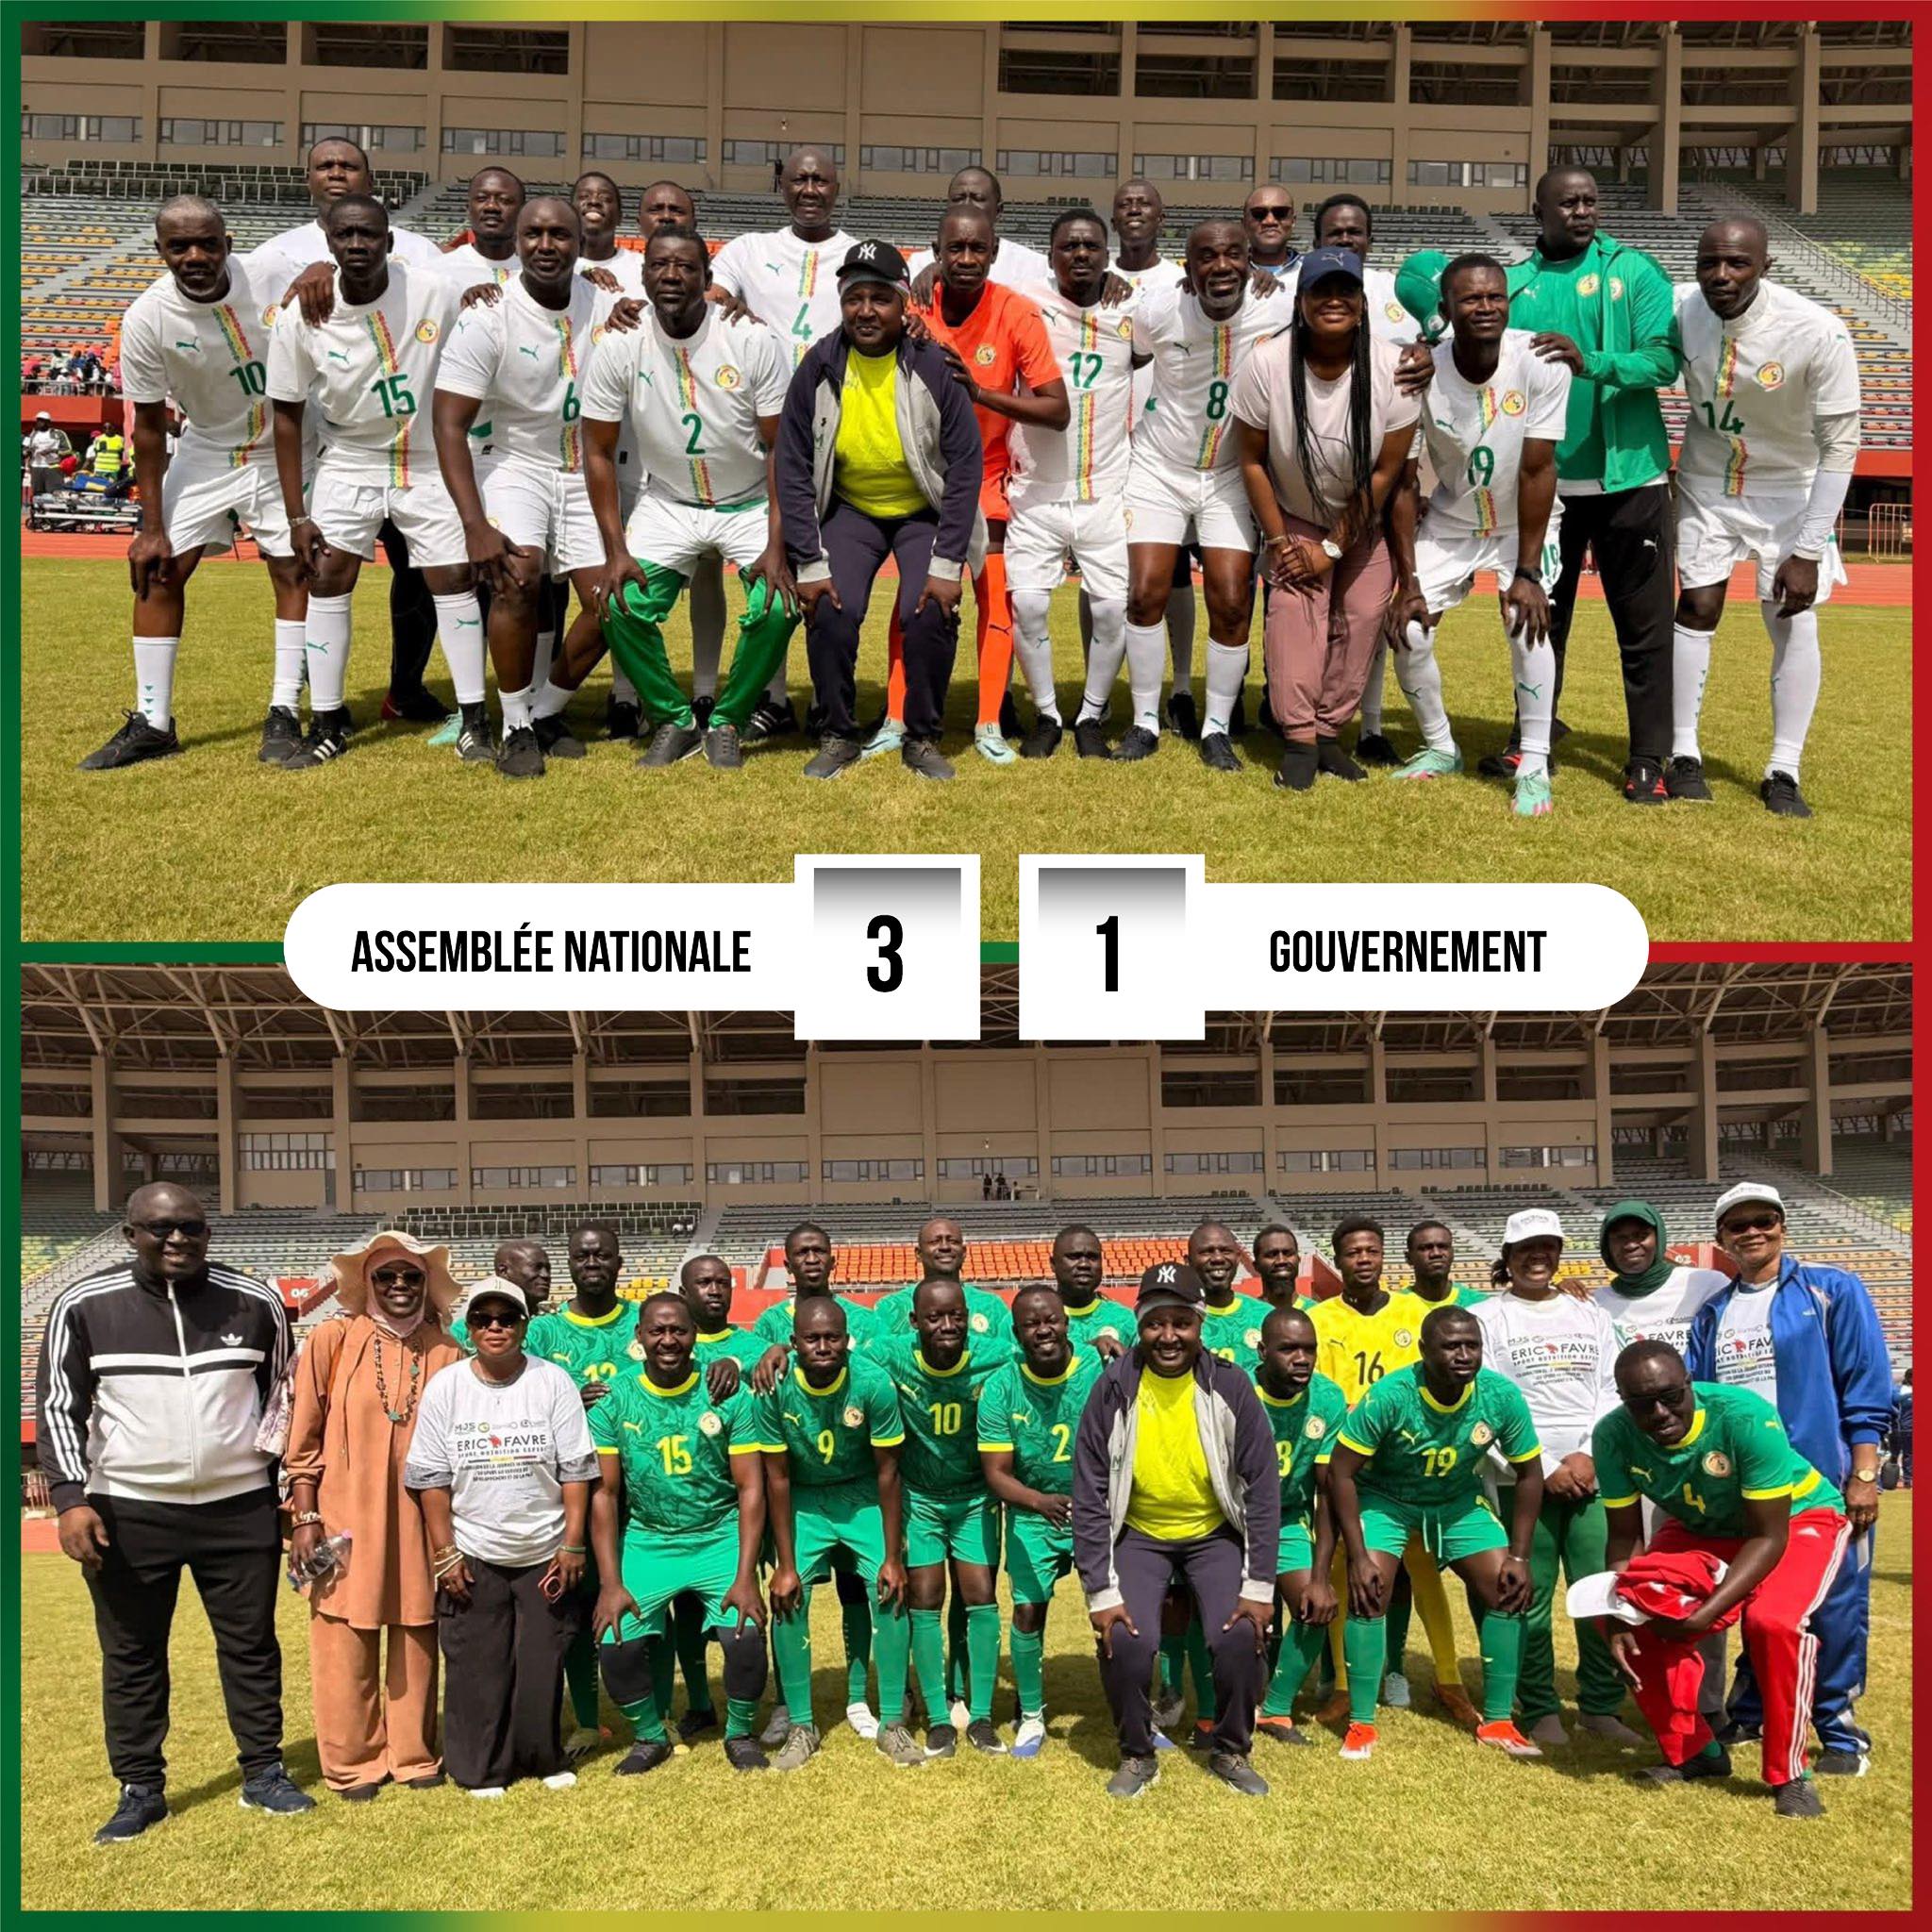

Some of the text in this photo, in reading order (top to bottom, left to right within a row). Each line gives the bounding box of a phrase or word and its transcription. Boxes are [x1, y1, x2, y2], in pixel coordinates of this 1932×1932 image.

[791, 303, 812, 340] 4
[229, 361, 266, 395] 10
[371, 374, 416, 418] 15
[563, 382, 581, 422] 6
[1207, 380, 1228, 420] 8
[682, 413, 706, 455] 2
[1701, 400, 1745, 434] 14
[1511, 1343, 1599, 1360] ERIC FAVRE
[1749, 1337, 1773, 1350] FAV
[1354, 1351, 1385, 1386] 16
[928, 1403, 961, 1435] 10
[457, 1434, 546, 1452] ERIC FAVRE
[657, 1434, 692, 1475] 15
[818, 1430, 834, 1464] 9
[1051, 1424, 1071, 1462] 2
[1422, 1446, 1457, 1477] 19
[1683, 1482, 1706, 1515] 4
